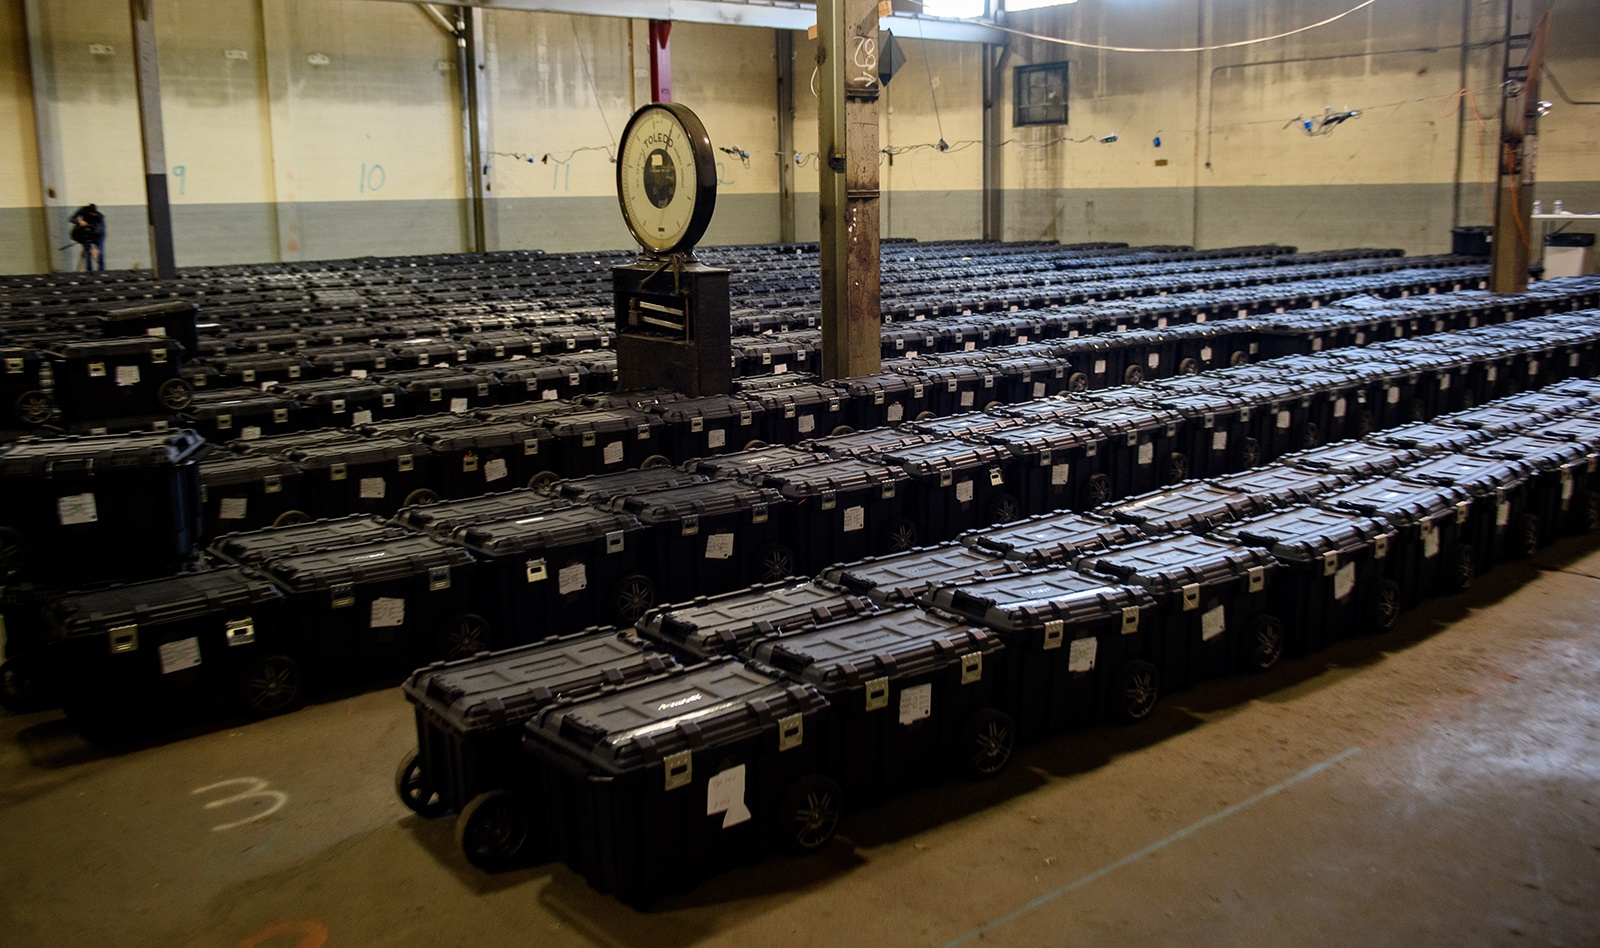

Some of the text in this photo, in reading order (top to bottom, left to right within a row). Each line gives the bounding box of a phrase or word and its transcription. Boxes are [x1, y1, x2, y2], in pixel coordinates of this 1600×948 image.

[643, 132, 674, 149] TOLEDO
[172, 164, 187, 196] 9
[358, 162, 387, 193] 10
[552, 163, 570, 191] 11
[191, 776, 288, 832] 3
